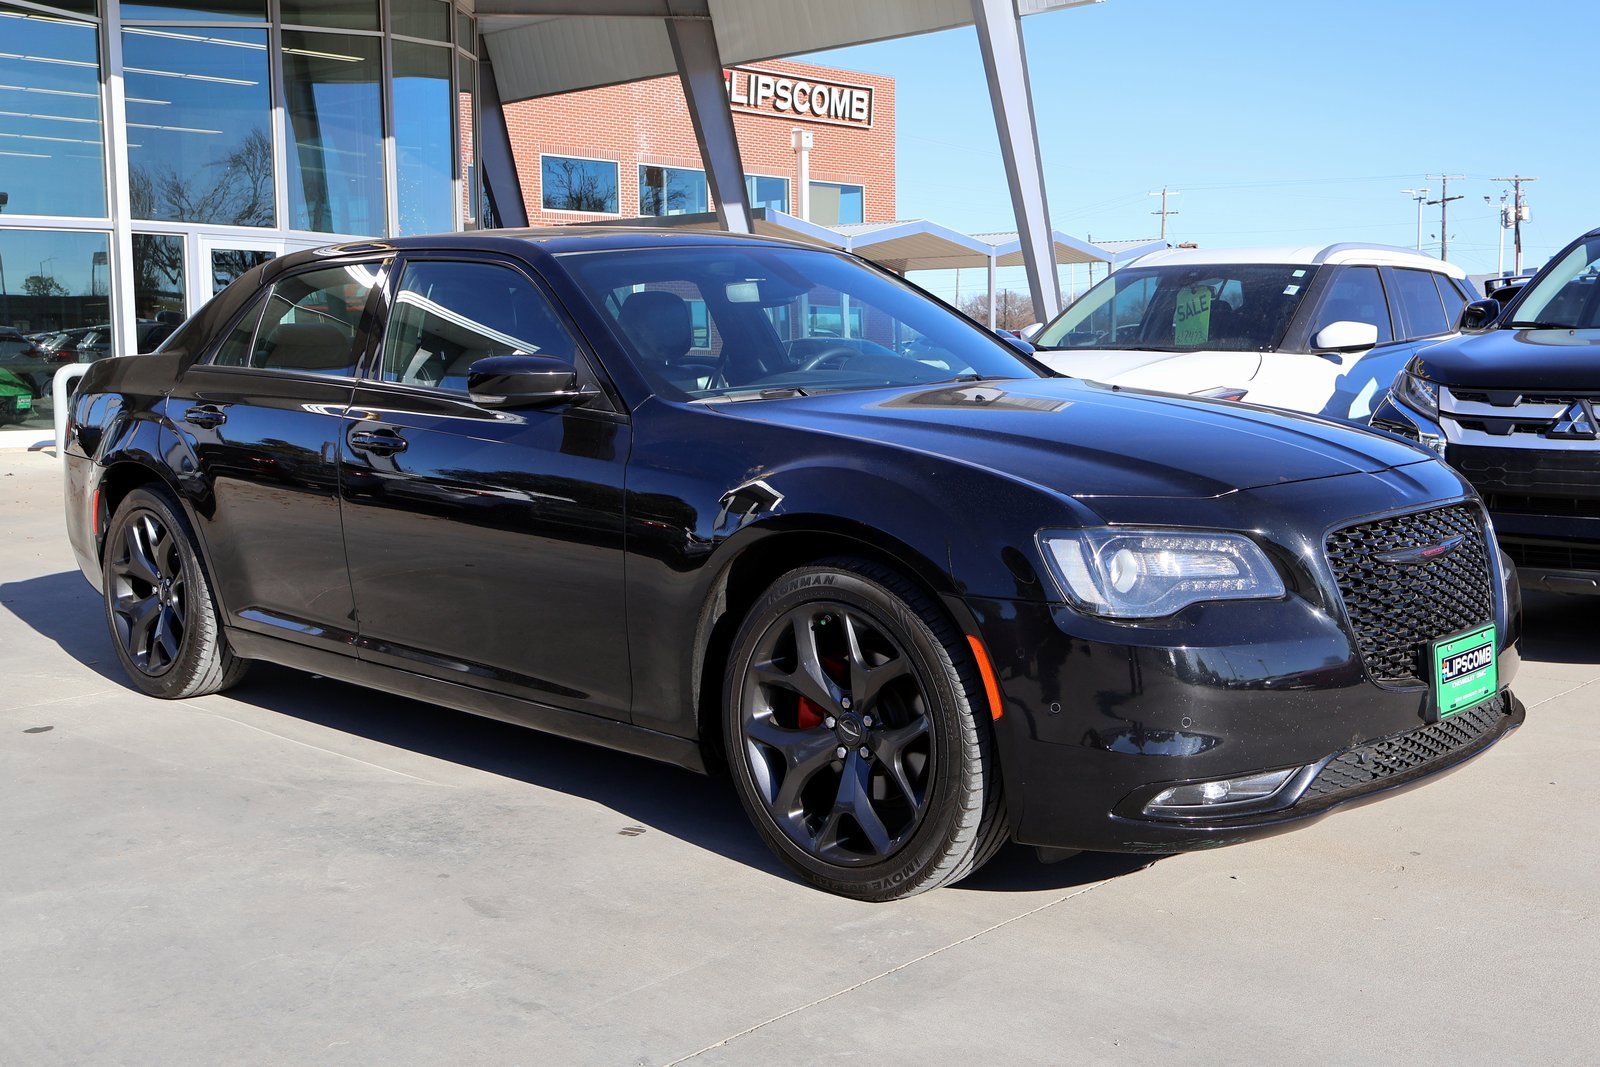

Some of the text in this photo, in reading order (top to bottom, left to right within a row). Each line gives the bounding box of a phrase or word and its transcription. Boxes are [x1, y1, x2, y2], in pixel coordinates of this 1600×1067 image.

[731, 71, 867, 120] LIPSCOMB
[1177, 295, 1209, 321] SALE
[1446, 646, 1491, 678] LIPSCOMB
